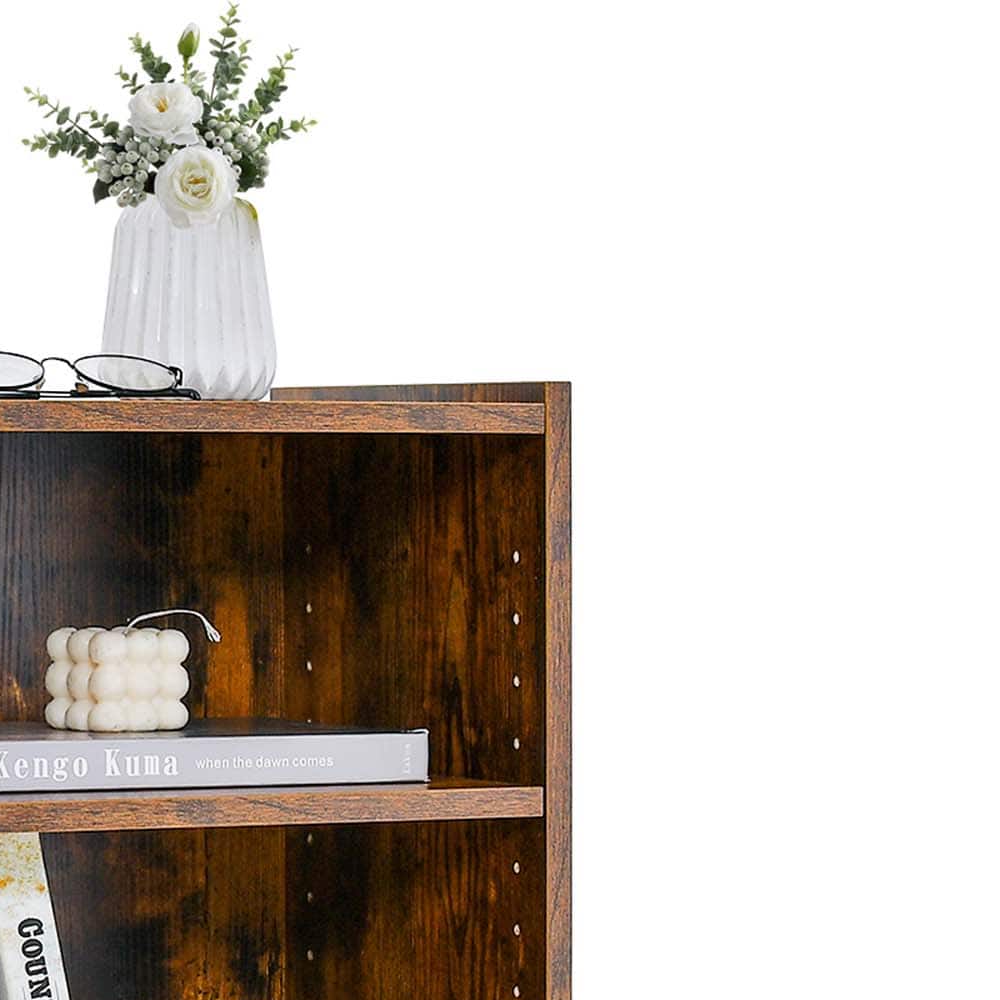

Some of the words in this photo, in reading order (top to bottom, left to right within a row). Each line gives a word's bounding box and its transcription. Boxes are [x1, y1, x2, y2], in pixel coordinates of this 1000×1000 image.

[104, 748, 179, 777] Kuma
[196, 757, 229, 769] when
[233, 756, 253, 769] the
[255, 755, 290, 768] dawn
[292, 756, 334, 767] comes
